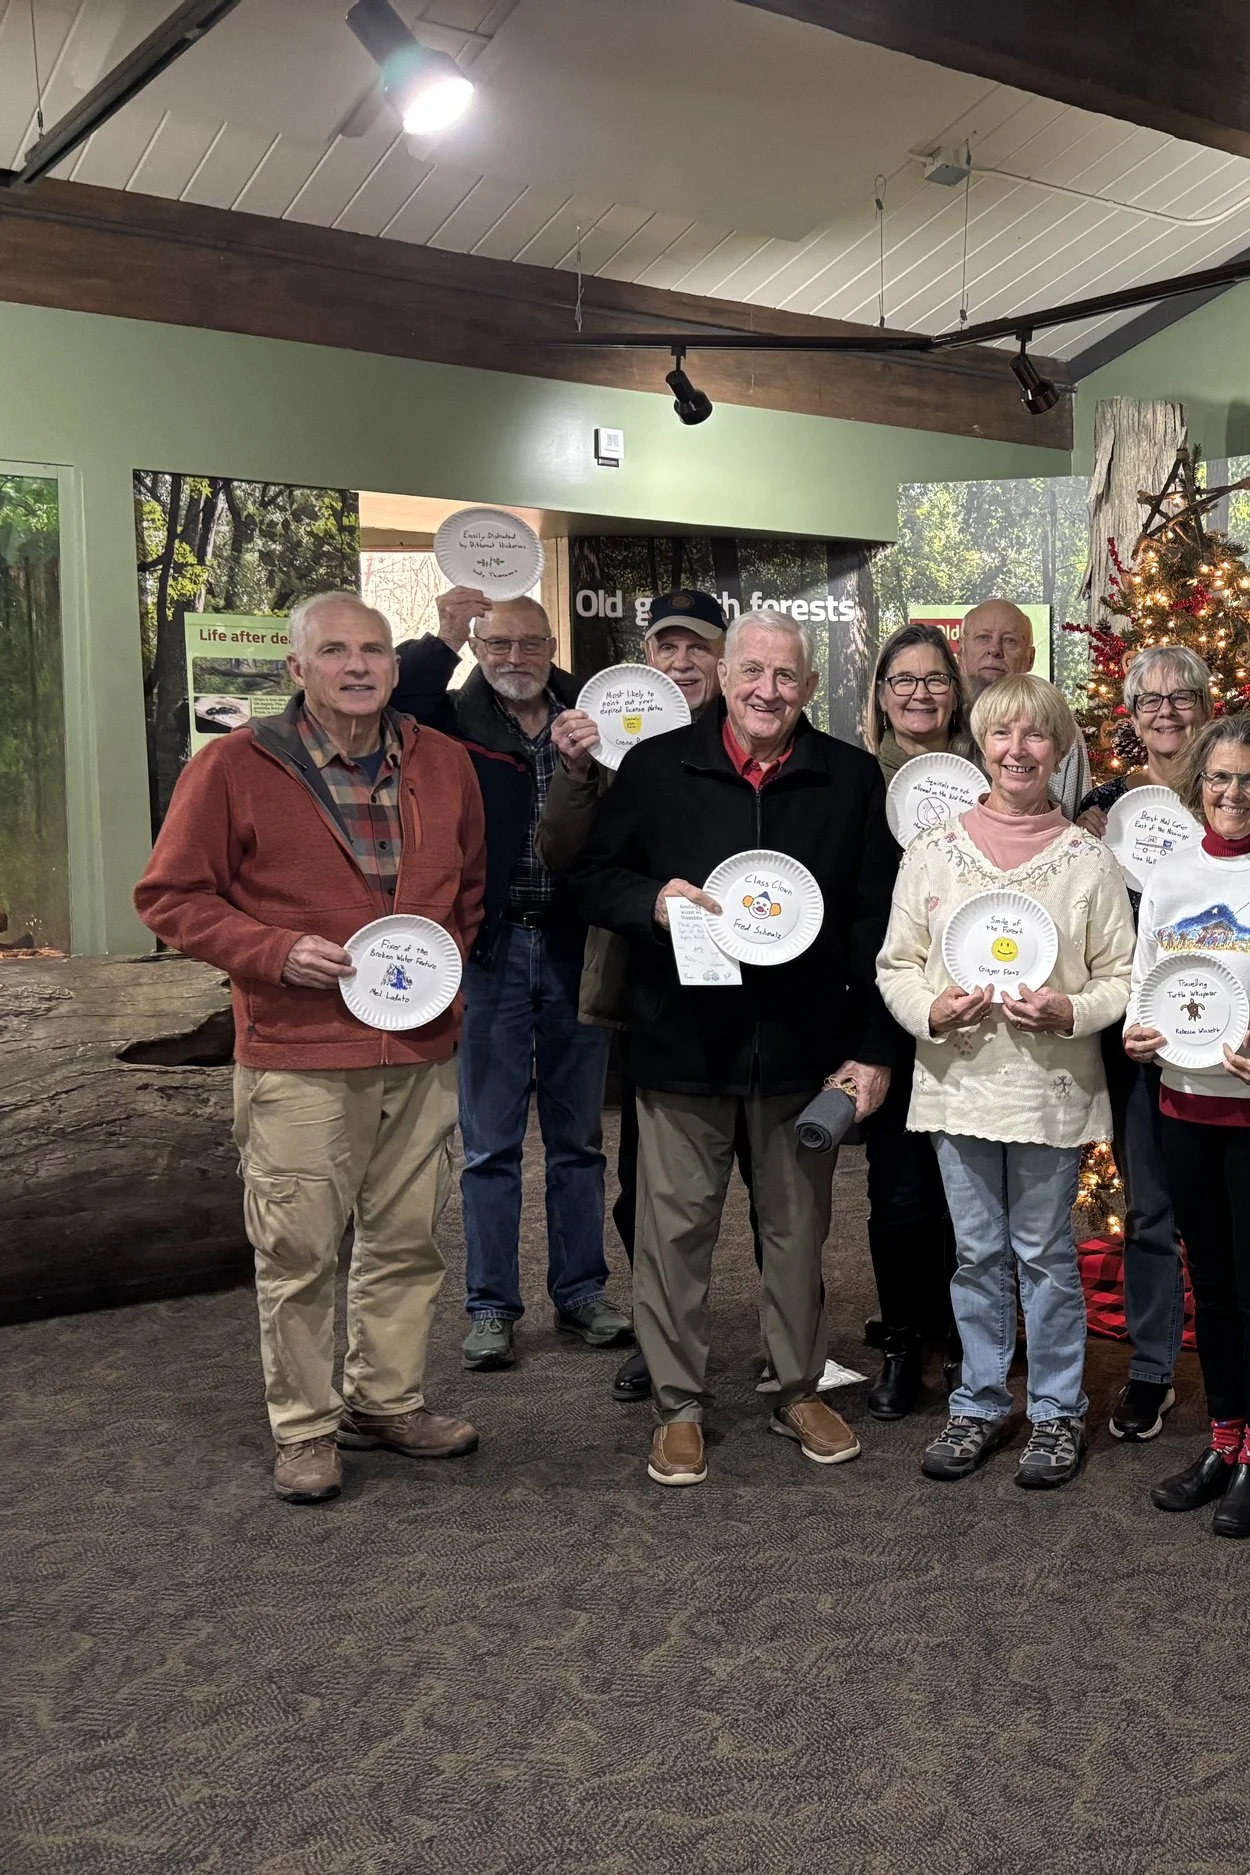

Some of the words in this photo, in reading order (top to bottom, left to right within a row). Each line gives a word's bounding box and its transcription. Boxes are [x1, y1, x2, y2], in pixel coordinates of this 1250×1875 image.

[575, 589, 622, 618] Old
[200, 629, 227, 642] Life
[231, 631, 266, 643] after
[271, 633, 290, 645] de
[606, 691, 623, 699] Most
[627, 690, 644, 698] likely
[602, 700, 619, 708] point
[600, 707, 622, 716] expired
[913, 784, 931, 794] allowed
[1140, 811, 1158, 822] Best
[1135, 821, 1147, 829] East
[745, 875, 769, 888] Class
[772, 880, 793, 896] Clown
[734, 919, 751, 931] Fred
[991, 916, 1008, 925] Smile
[1003, 926, 1023, 934] Forest
[381, 939, 400, 951] Fixer
[416, 948, 429, 956] the
[370, 949, 393, 960] Broken
[397, 955, 413, 964] Water
[416, 958, 437, 970] Feature
[979, 966, 1000, 976] Ginger
[1178, 979, 1208, 989] Travelling
[1190, 991, 1217, 999] Whisperer
